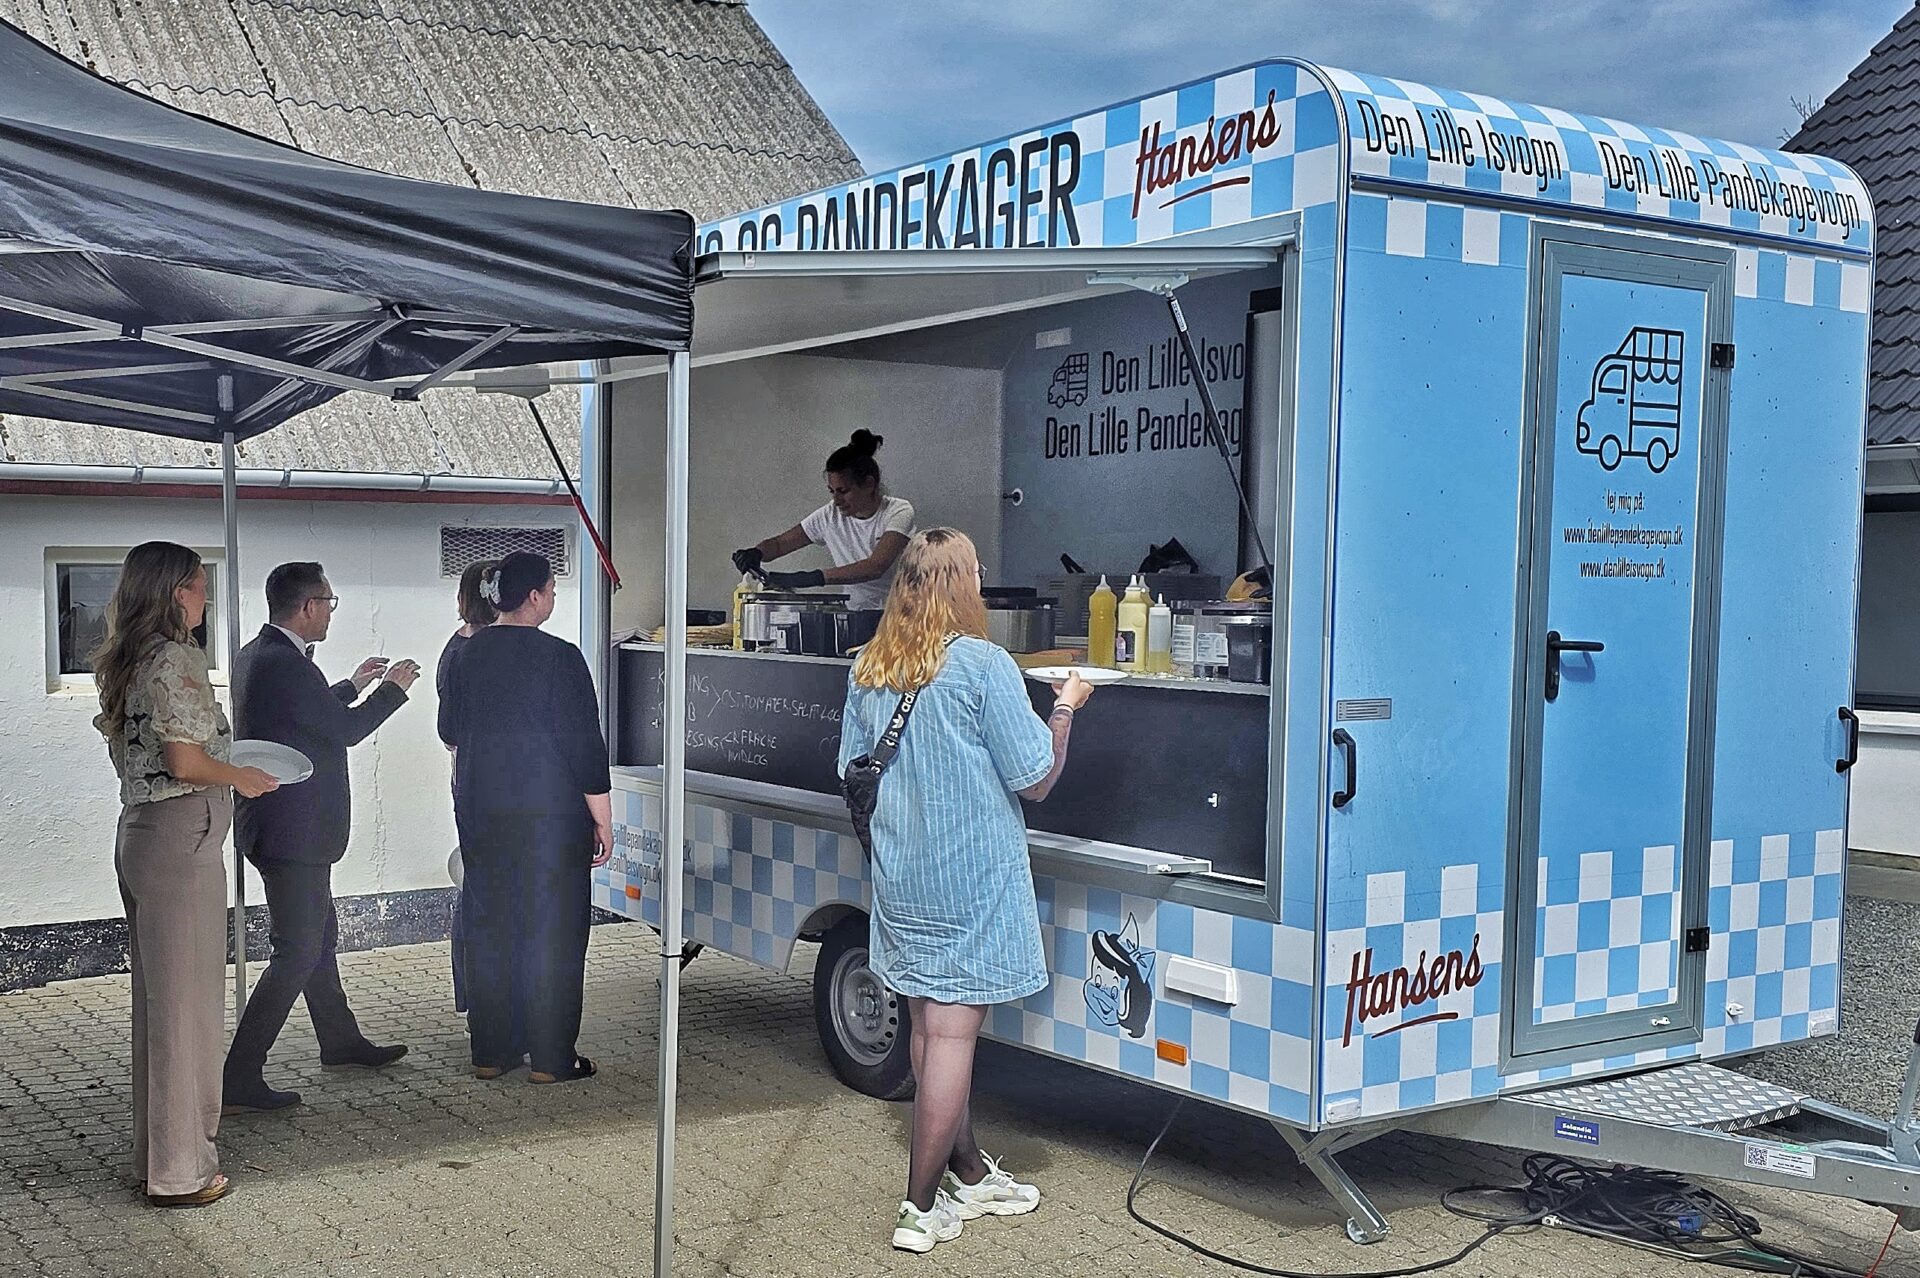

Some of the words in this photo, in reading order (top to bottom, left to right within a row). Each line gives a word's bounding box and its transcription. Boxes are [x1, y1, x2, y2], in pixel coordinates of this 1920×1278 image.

[1132, 89, 1281, 219] Hansens
[1357, 99, 1415, 158] Den
[1416, 108, 1475, 167] Lille
[1476, 119, 1562, 192] Isvogn
[1599, 140, 1650, 195] Den
[1649, 148, 1701, 203] Lille
[1700, 158, 1861, 240] Pandekagevogn
[1101, 351, 1140, 395] Den
[1148, 337, 1191, 390] Lille
[1200, 337, 1244, 383] Isvo
[1045, 417, 1081, 459] Den
[1089, 406, 1128, 456] Lille
[1137, 398, 1243, 457] Pandekag
[1607, 489, 1617, 514] lej
[1618, 491, 1632, 514] mig
[1563, 522, 1683, 549] www.denlillepandekagevogn.dk
[1580, 557, 1666, 582] www.denlilleisvogn.dk
[1343, 933, 1485, 1049] Hansens
